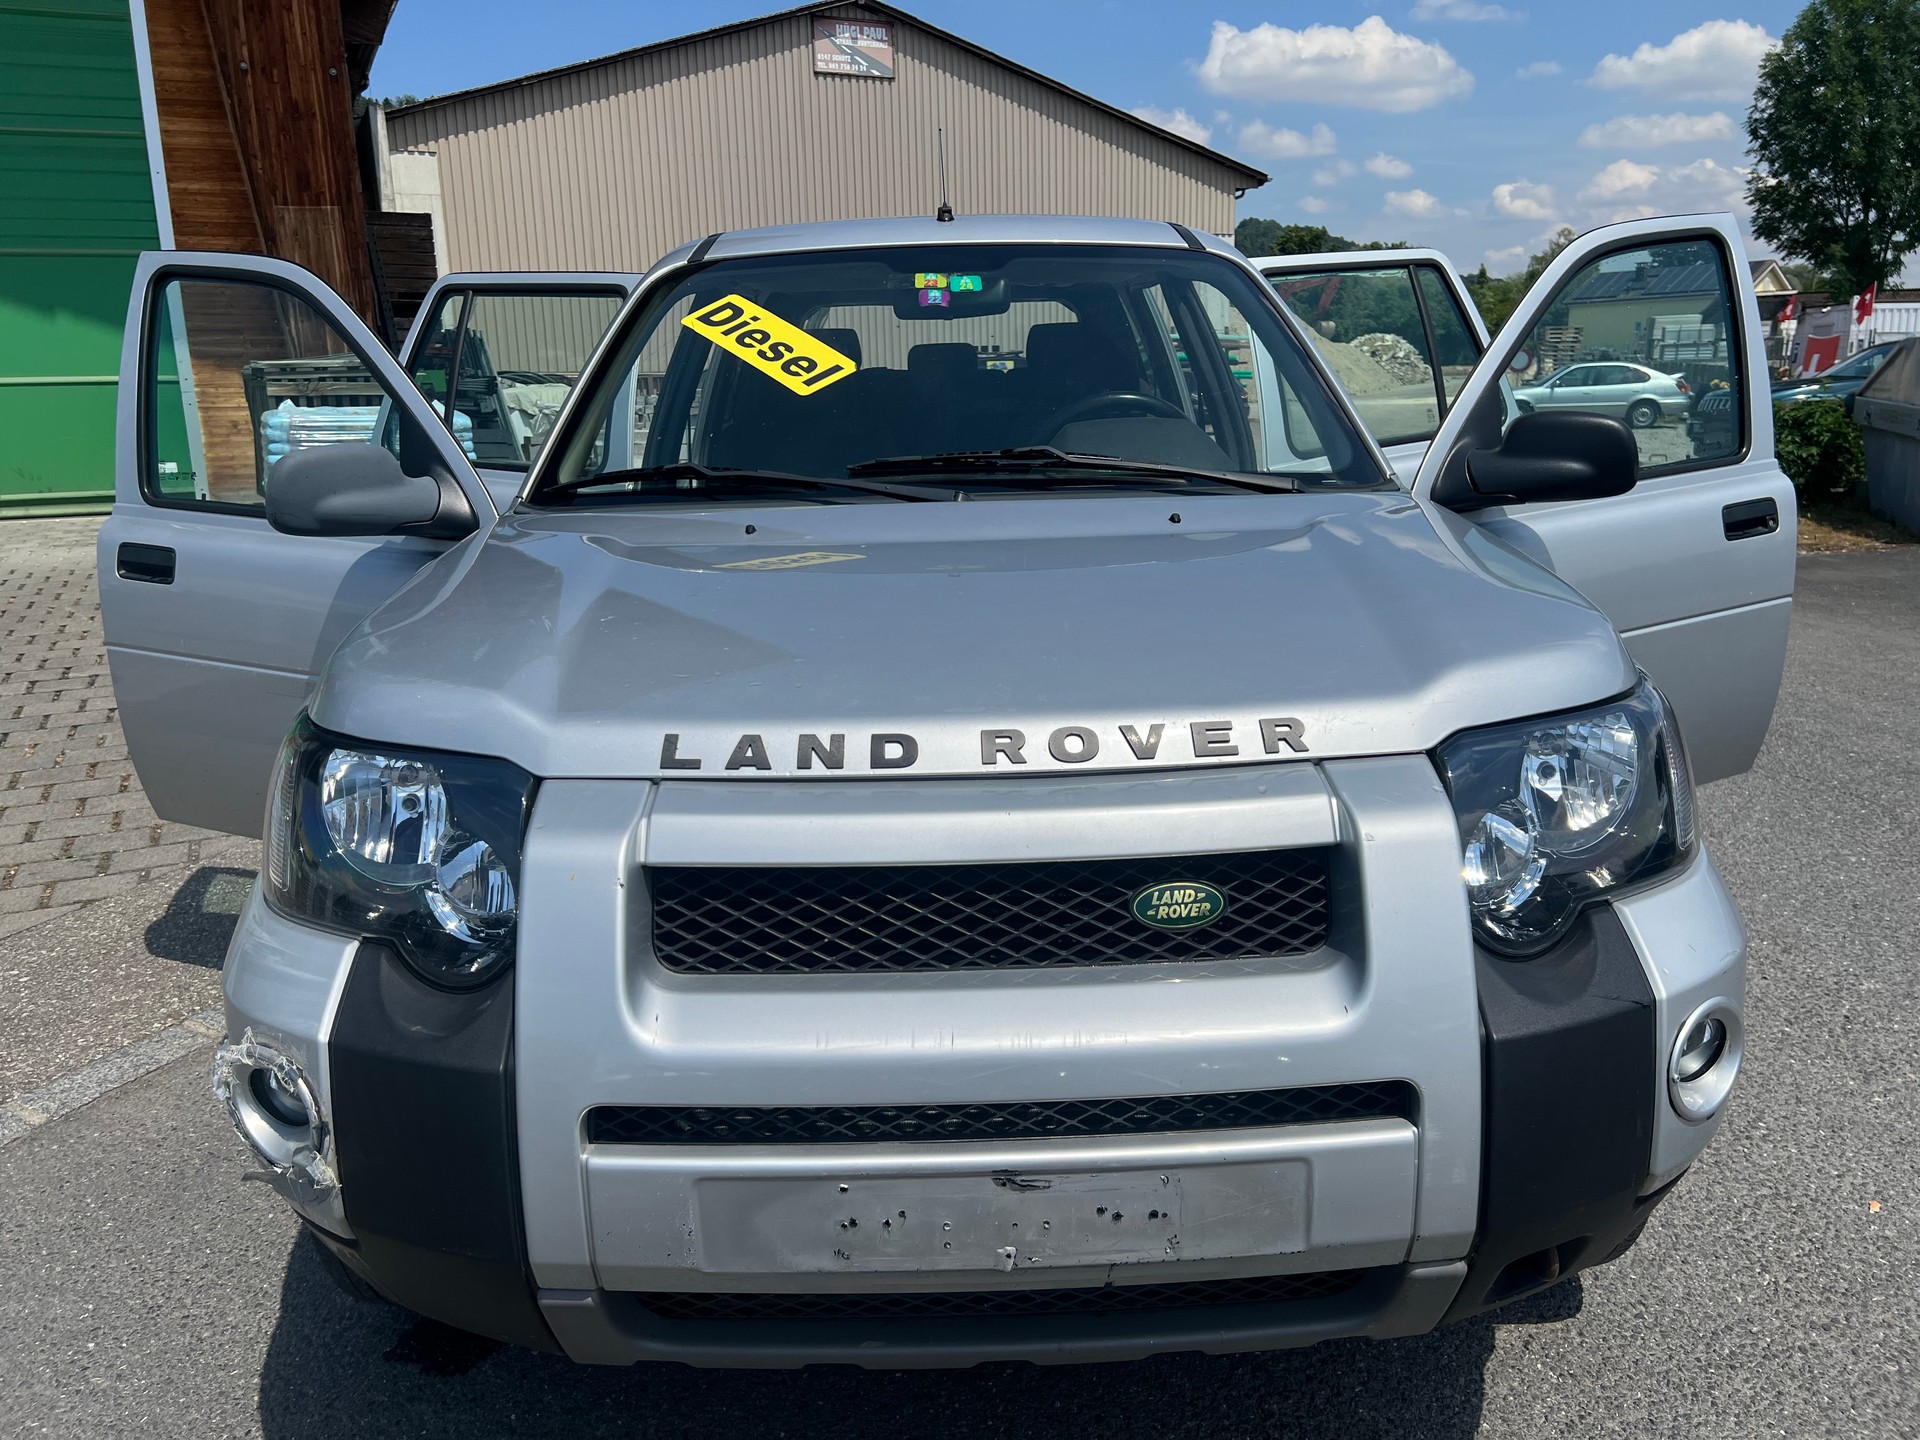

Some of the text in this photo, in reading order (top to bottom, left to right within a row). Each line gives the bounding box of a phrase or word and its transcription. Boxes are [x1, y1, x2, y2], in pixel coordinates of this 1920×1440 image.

[863, 26, 888, 40] PAUL
[924, 279, 938, 287] 23
[695, 301, 845, 387] Diesel
[660, 717, 1310, 770] LAND ROVER
